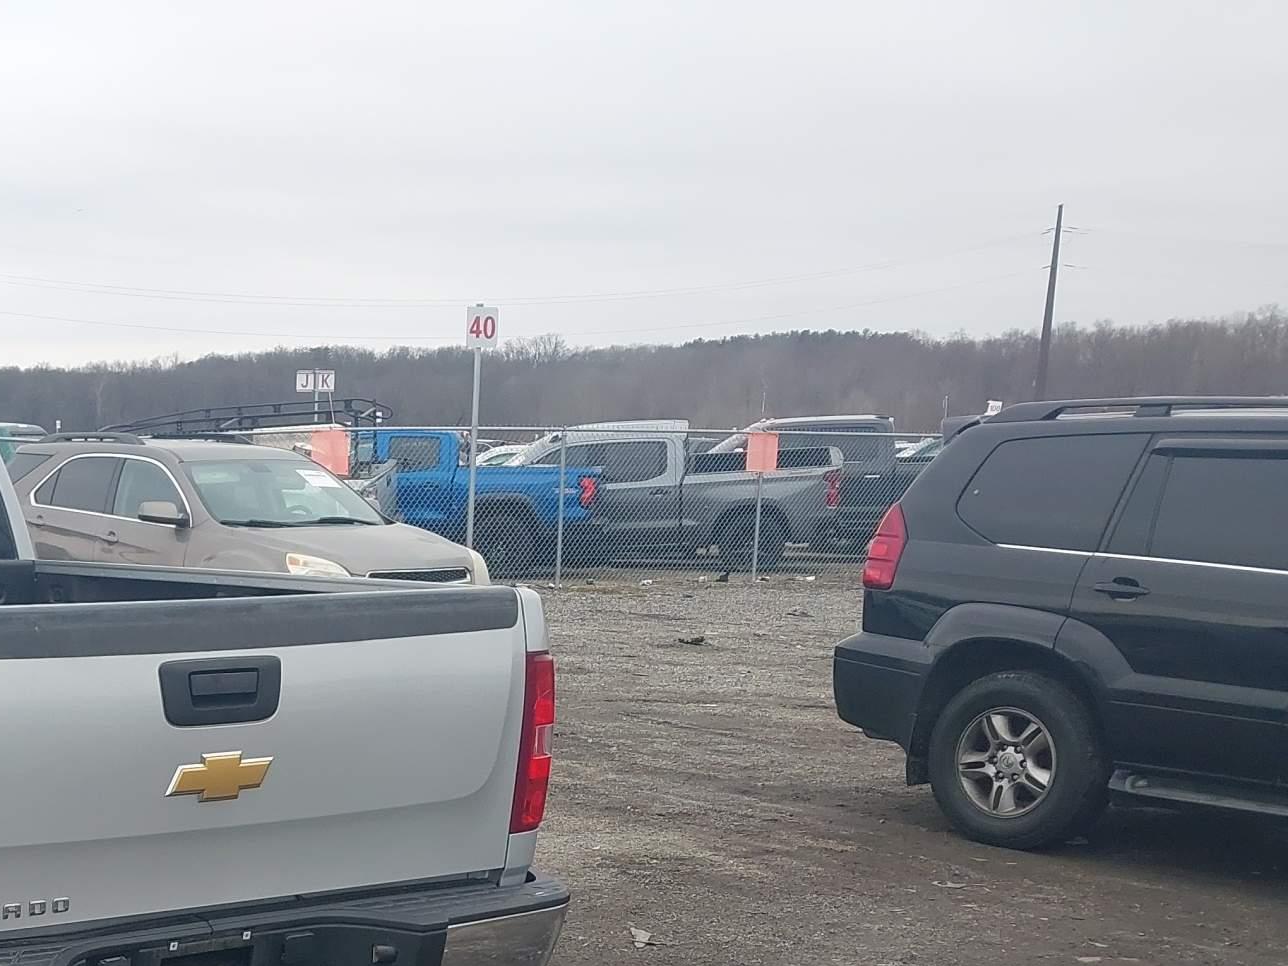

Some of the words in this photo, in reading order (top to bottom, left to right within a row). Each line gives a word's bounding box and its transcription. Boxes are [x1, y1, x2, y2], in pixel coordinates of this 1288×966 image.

[469, 315, 496, 340] 40
[300, 374, 310, 389] J
[321, 374, 331, 389] K
